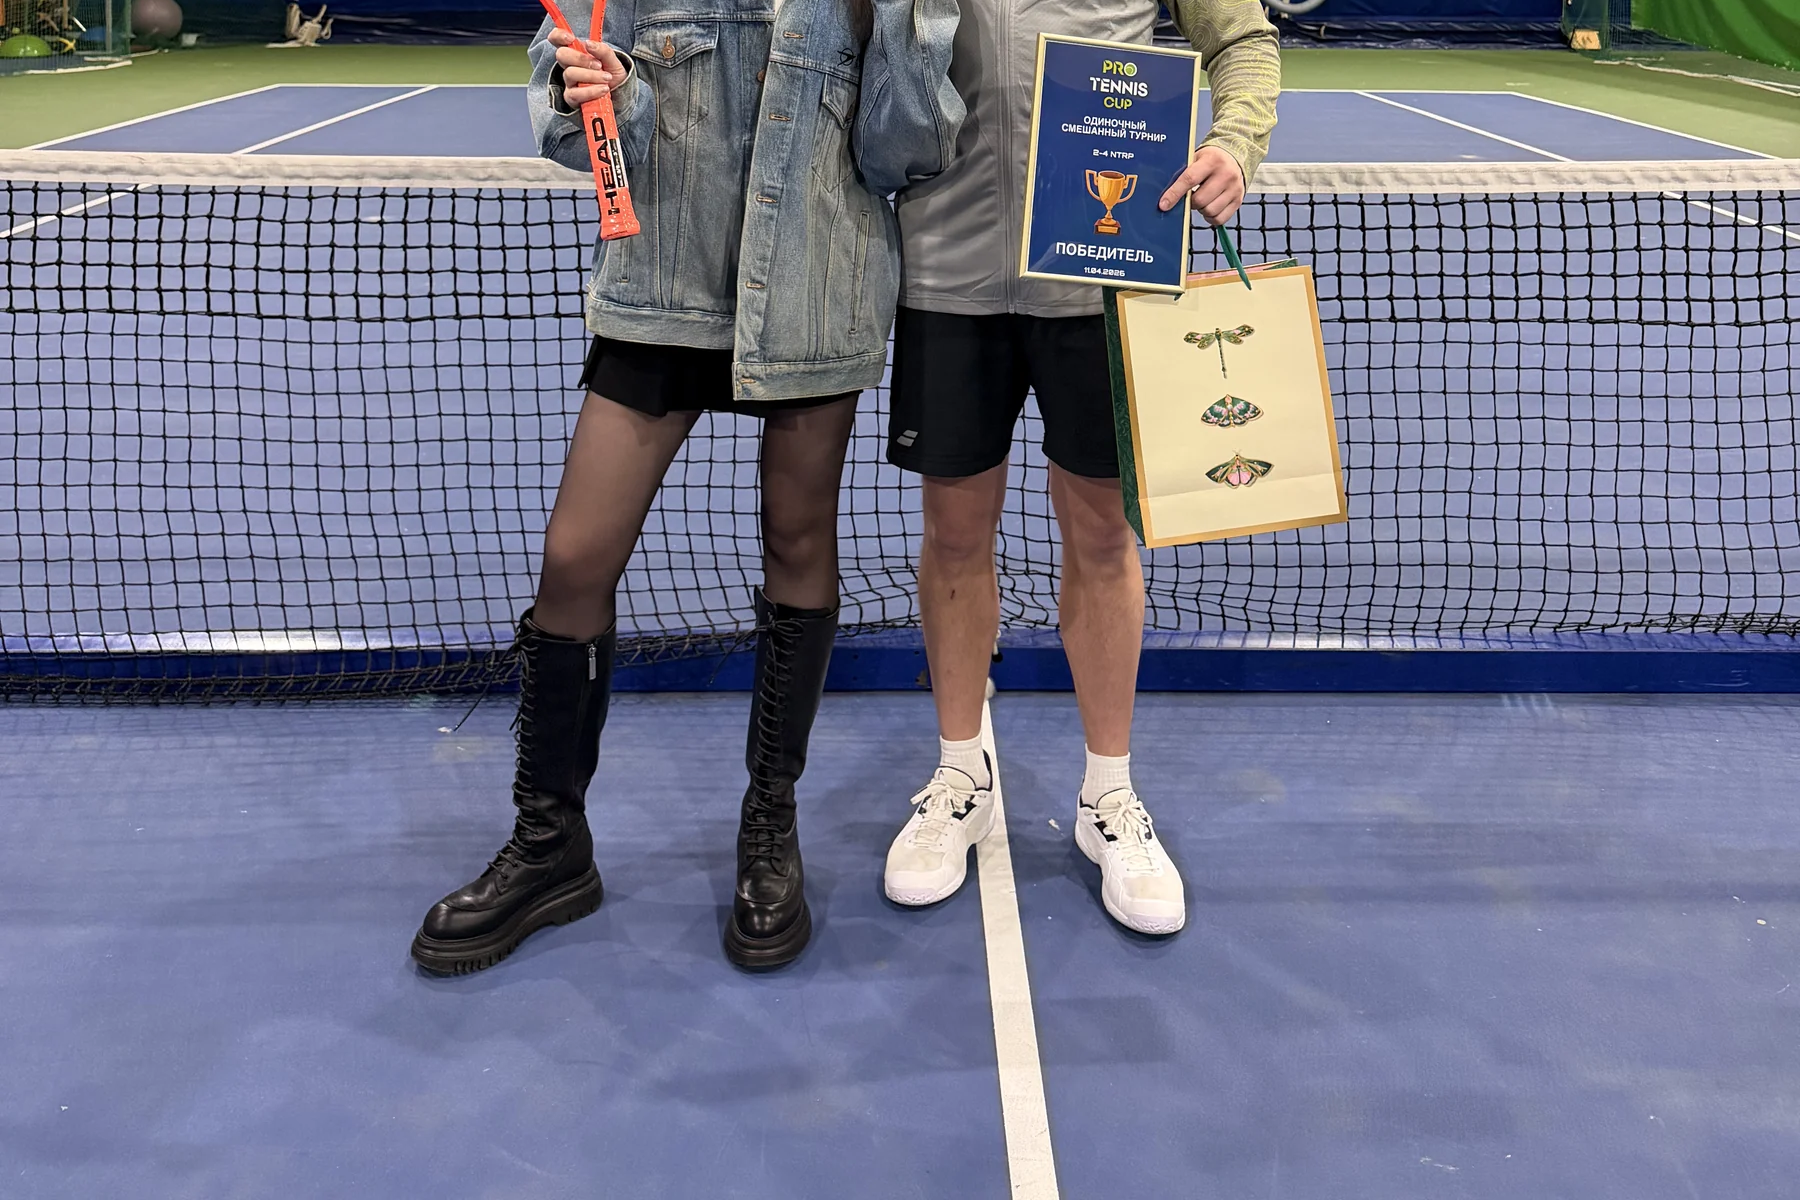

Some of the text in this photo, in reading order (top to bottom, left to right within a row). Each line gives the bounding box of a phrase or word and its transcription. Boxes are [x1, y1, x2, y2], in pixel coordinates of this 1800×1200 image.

[1102, 60, 1137, 77] PRO
[1089, 77, 1149, 97] TENNIS
[1103, 97, 1133, 110] CUP
[1083, 116, 1147, 131] ОДИНОЧНЫЙ
[1061, 123, 1167, 143] СМЕШАННЫЙ ТУРНИР
[1092, 149, 1135, 160] 2-4 NTRP
[591, 117, 621, 215] HEAD
[1055, 242, 1154, 264] ПОБЕДИТЕЛЬ
